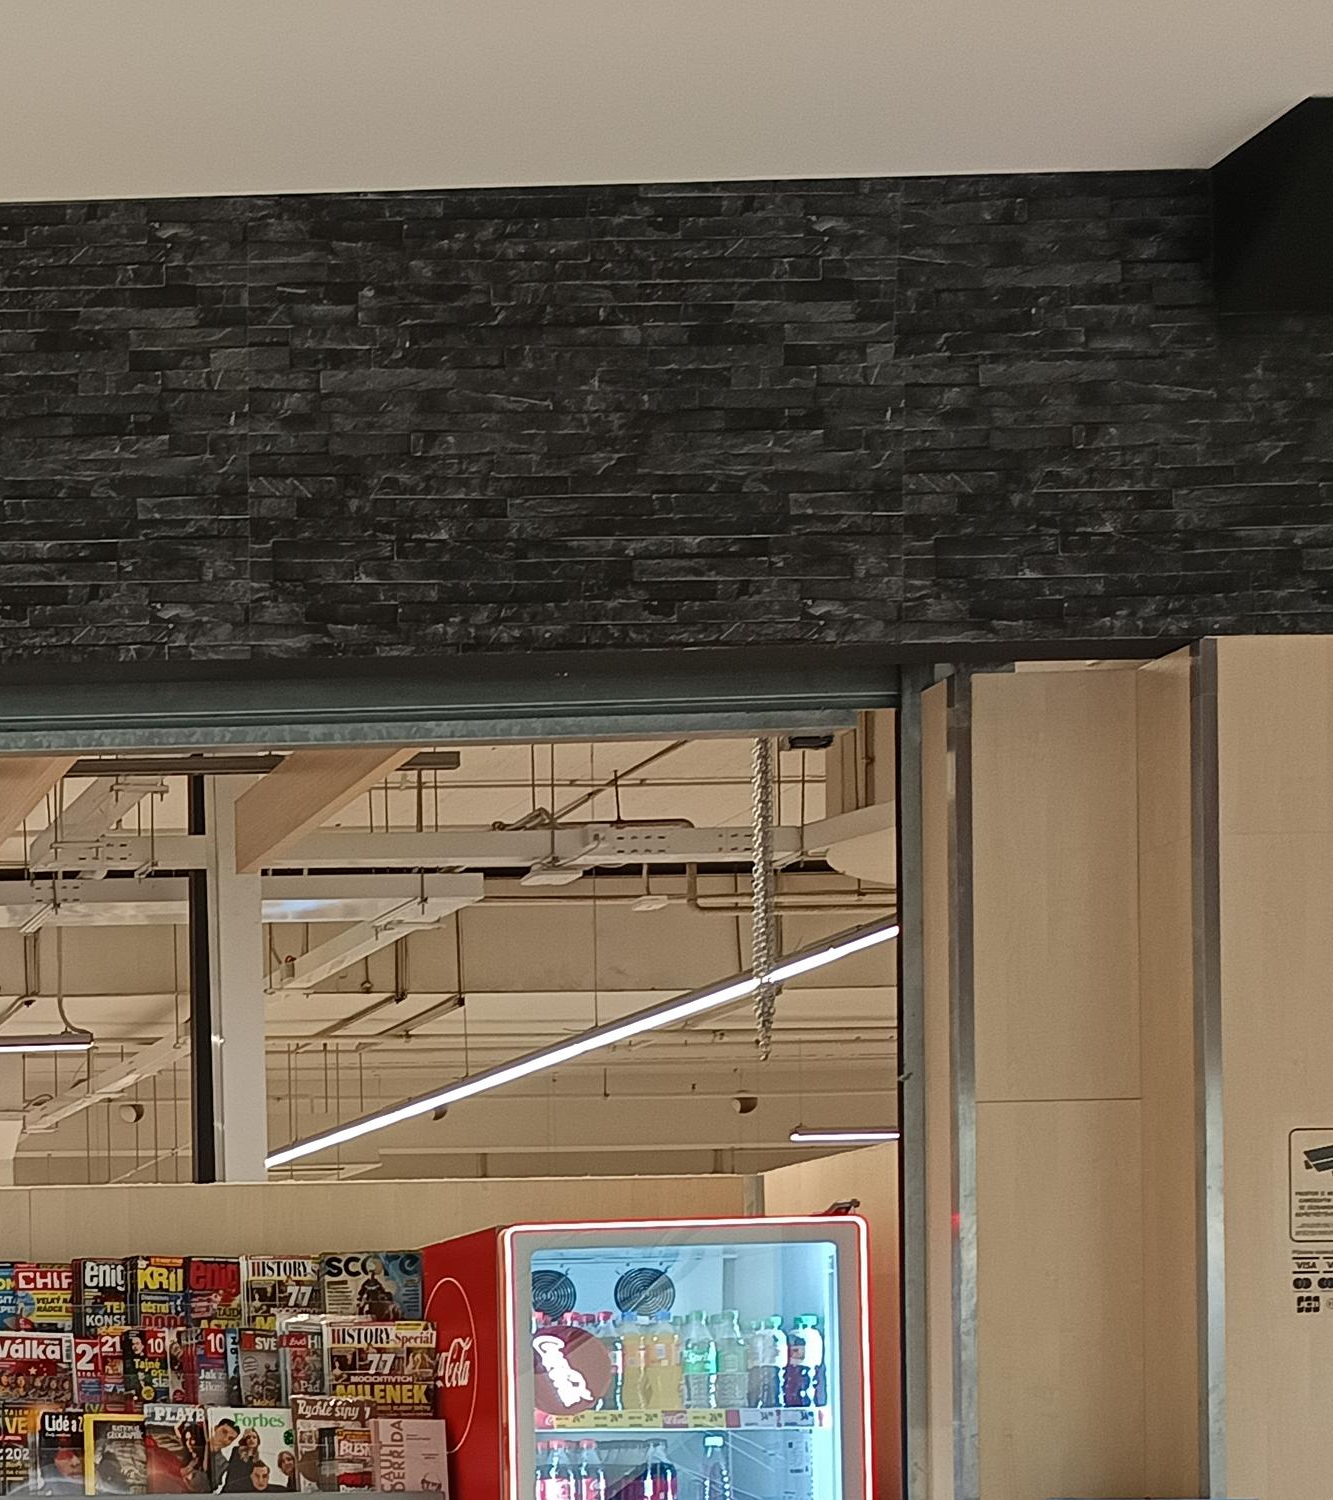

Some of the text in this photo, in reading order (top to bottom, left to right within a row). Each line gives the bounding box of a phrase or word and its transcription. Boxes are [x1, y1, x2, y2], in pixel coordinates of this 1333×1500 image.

[1296, 1261, 1316, 1269] VISA
[367, 1354, 395, 1374] 77
[336, 1384, 428, 1403] MILENEK
[45, 1415, 69, 1432] Lidé
[234, 1413, 285, 1429] Forbes
[391, 1420, 405, 1493] DERRIDA
